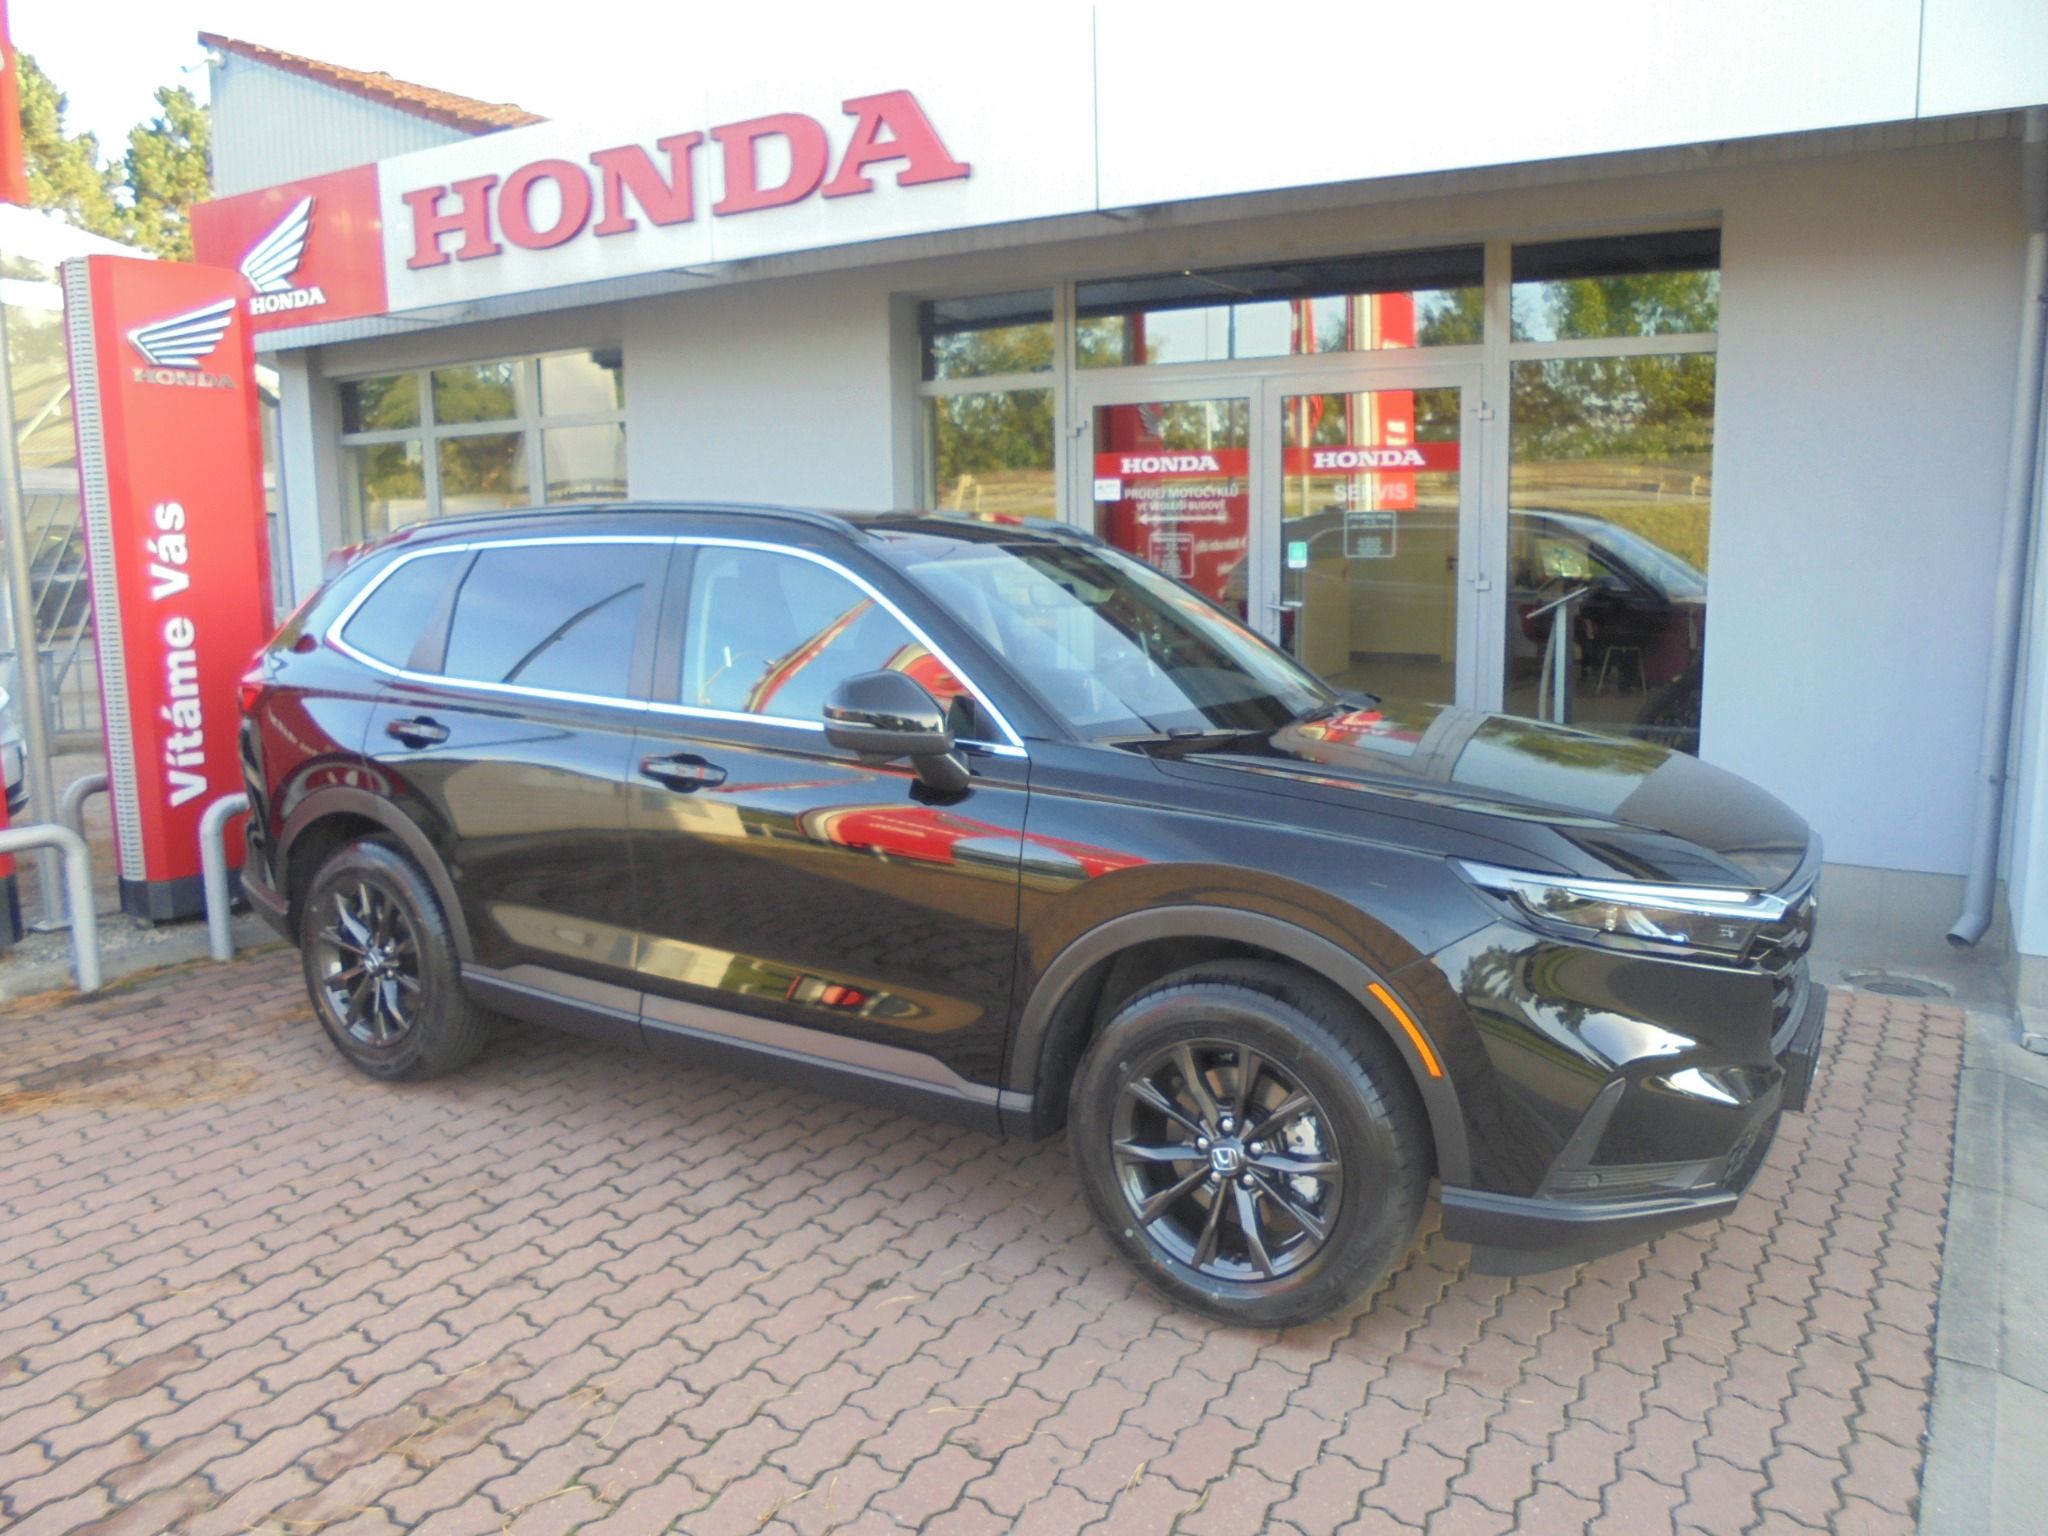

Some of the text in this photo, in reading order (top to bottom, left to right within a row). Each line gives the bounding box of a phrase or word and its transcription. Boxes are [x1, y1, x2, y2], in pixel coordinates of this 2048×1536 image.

[402, 89, 971, 270] HONDA
[250, 286, 326, 315] HONDA
[133, 367, 235, 388] HONDA
[1120, 455, 1220, 474] HONDA
[1312, 449, 1426, 469] HONDA
[148, 501, 208, 808] Vítáme Vás
